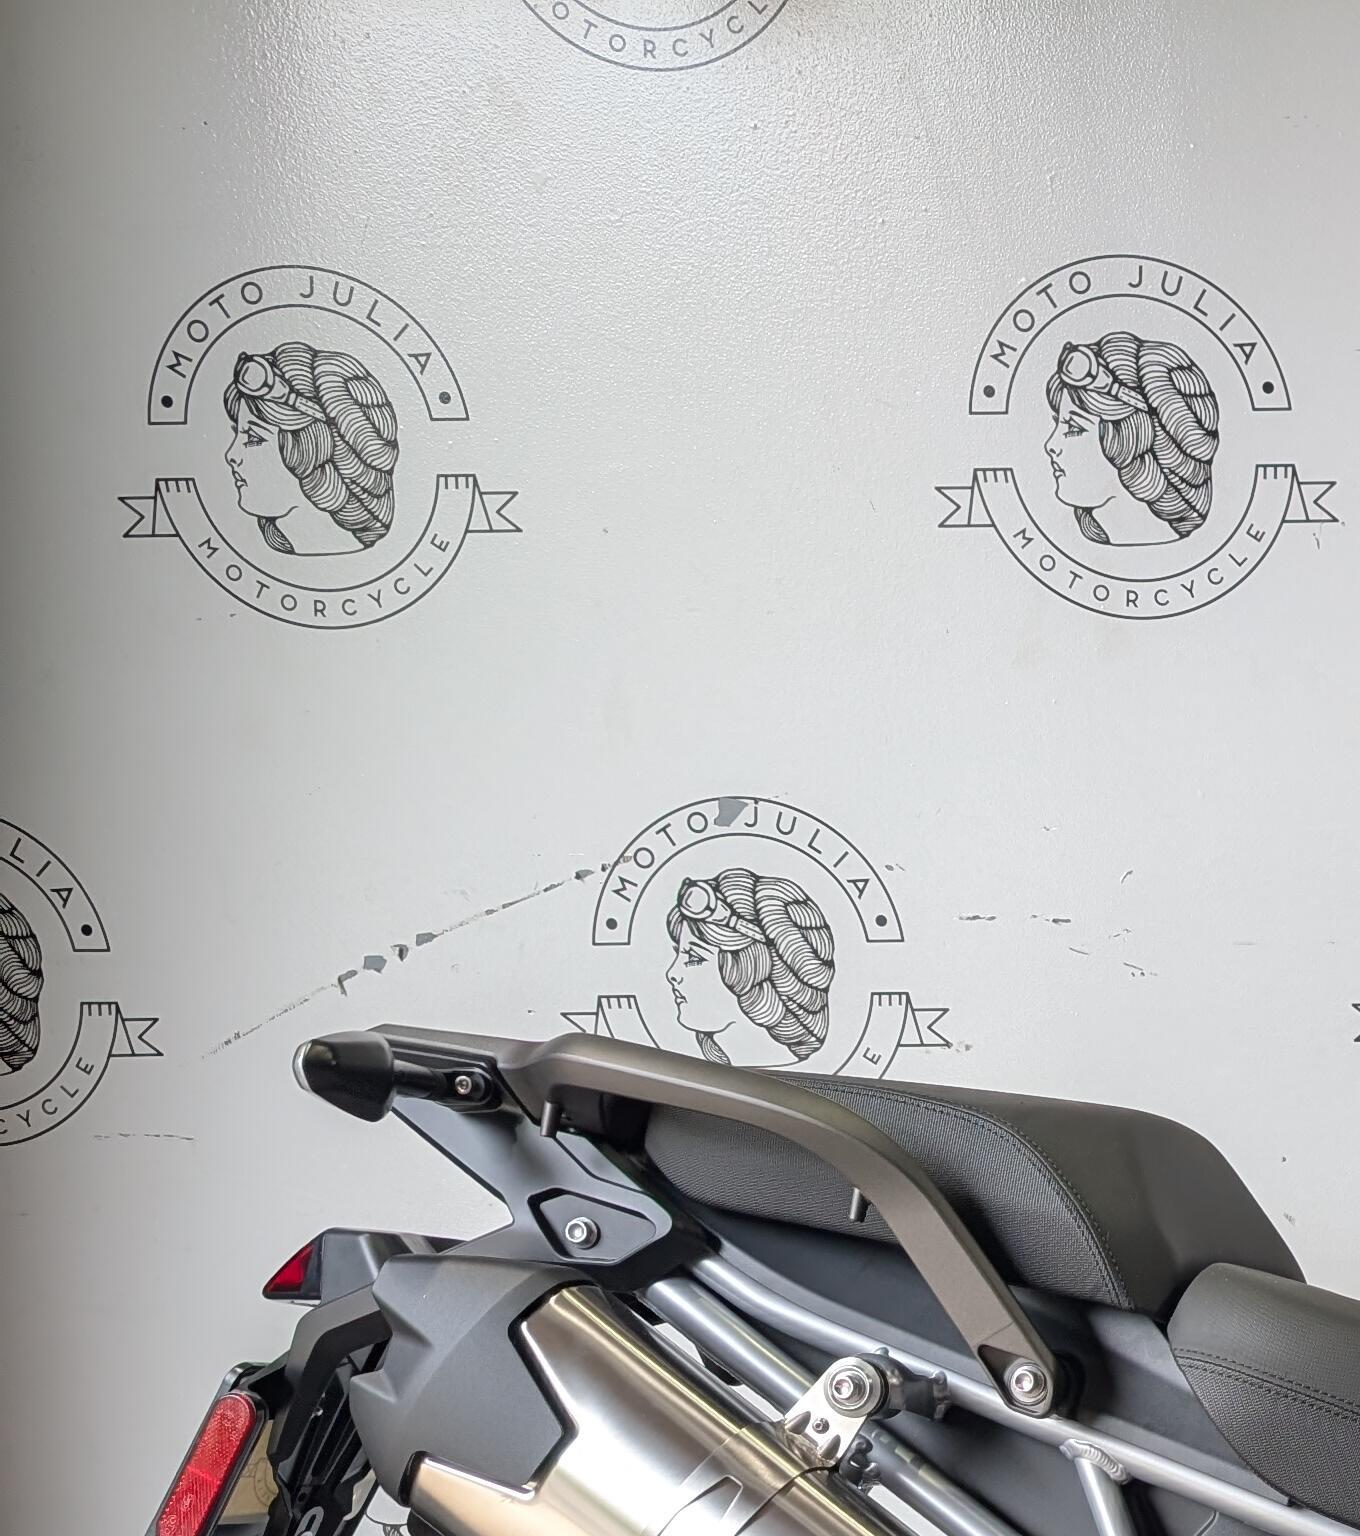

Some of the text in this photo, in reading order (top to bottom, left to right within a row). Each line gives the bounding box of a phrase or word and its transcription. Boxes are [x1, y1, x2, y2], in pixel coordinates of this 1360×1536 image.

[552, 0, 768, 58] OTORCYCL
[166, 275, 432, 379] MOTO JULIA
[990, 265, 1258, 368] MOTO JULIA
[198, 533, 450, 619] MOTORCYCLE
[1013, 523, 1266, 609] MOTORCYCLE
[9, 836, 74, 909] LIA
[611, 800, 870, 902] MOTO JULIA
